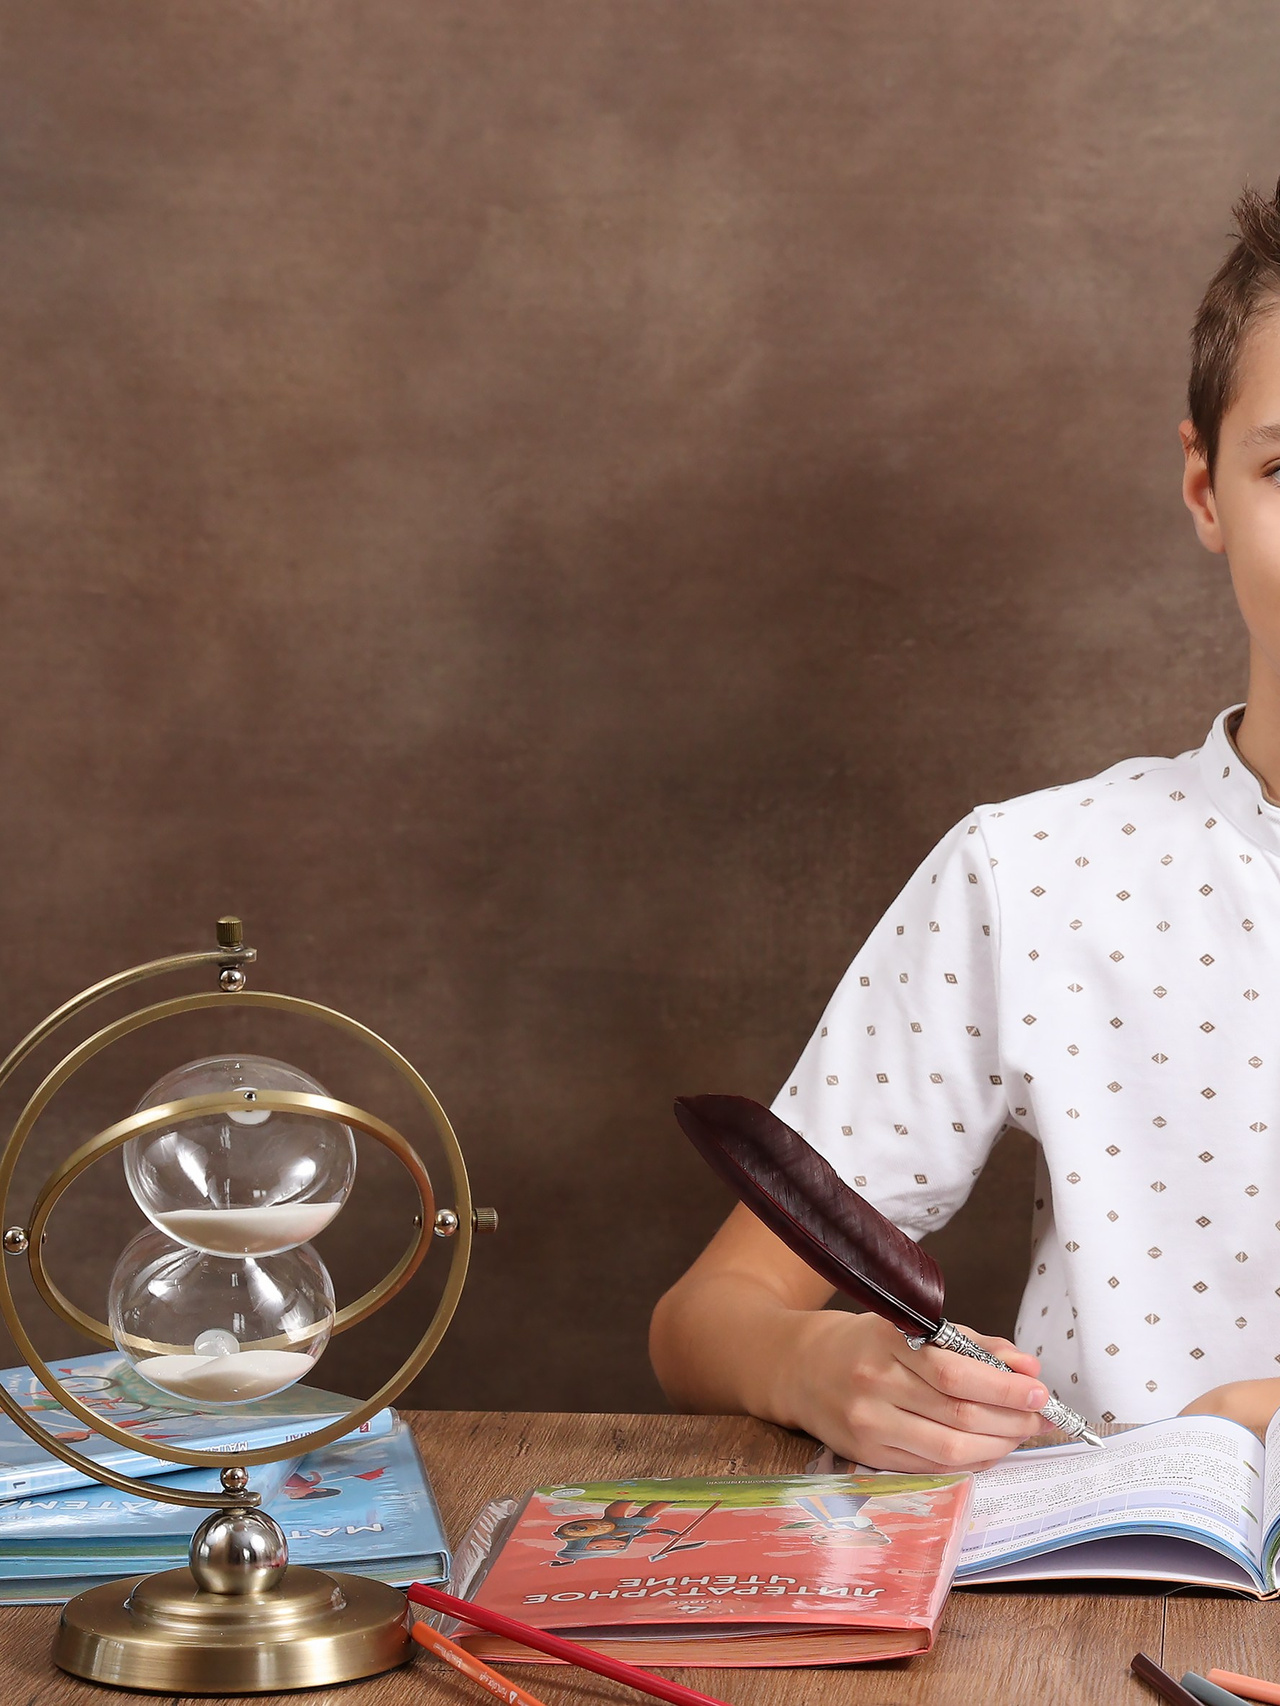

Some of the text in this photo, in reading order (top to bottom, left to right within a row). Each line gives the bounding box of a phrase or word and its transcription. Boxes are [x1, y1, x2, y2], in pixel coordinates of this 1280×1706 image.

[618, 1574, 796, 1590] ЧТЕНИЕ
[522, 1583, 886, 1606] ЛИТЕРАТУРНОЕ
[674, 1604, 708, 1614] 4
